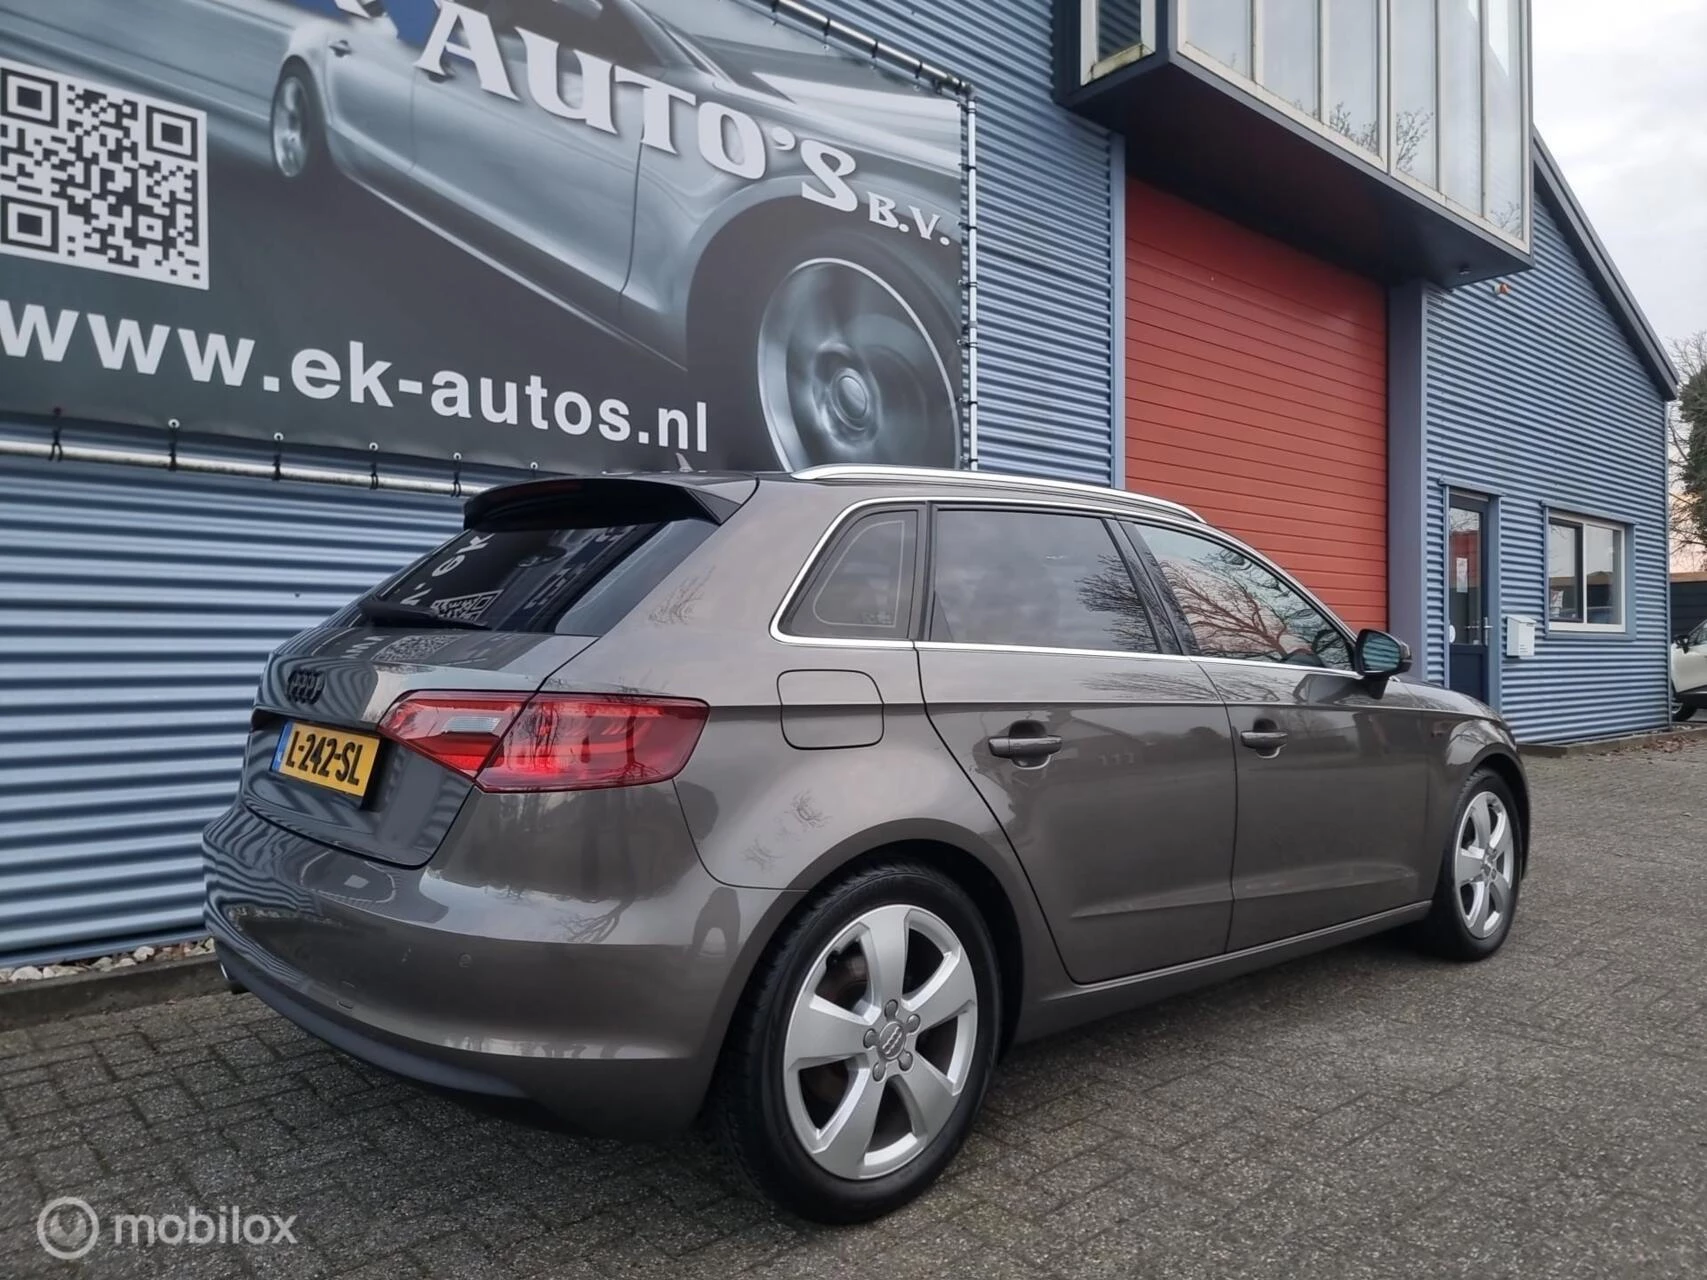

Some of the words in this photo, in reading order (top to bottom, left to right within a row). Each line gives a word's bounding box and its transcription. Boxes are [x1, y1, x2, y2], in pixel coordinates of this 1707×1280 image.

[866, 191, 951, 246] B.V.
[0, 299, 708, 453] www.ek-autos.nl
[285, 730, 364, 786] L-242-SL
